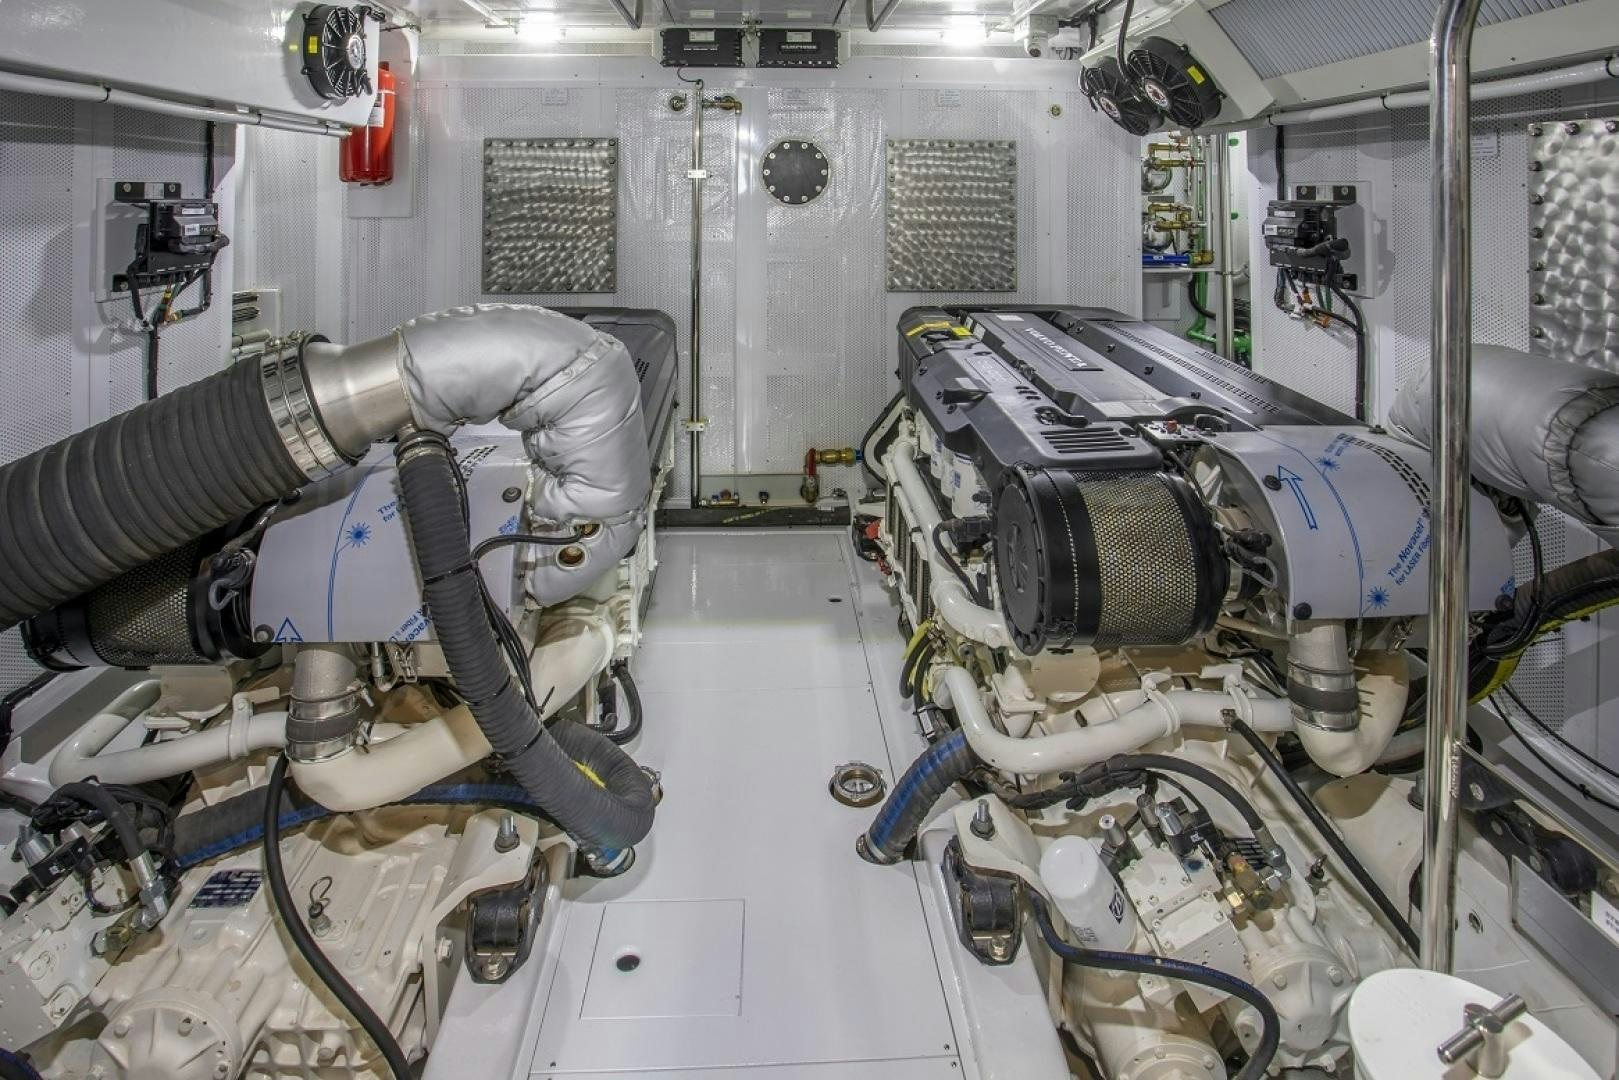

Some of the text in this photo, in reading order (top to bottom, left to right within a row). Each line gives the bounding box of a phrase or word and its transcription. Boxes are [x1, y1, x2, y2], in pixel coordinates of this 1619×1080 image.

[1025, 327, 1088, 367] VOLVO PENTA
[1388, 562, 1402, 577] The
